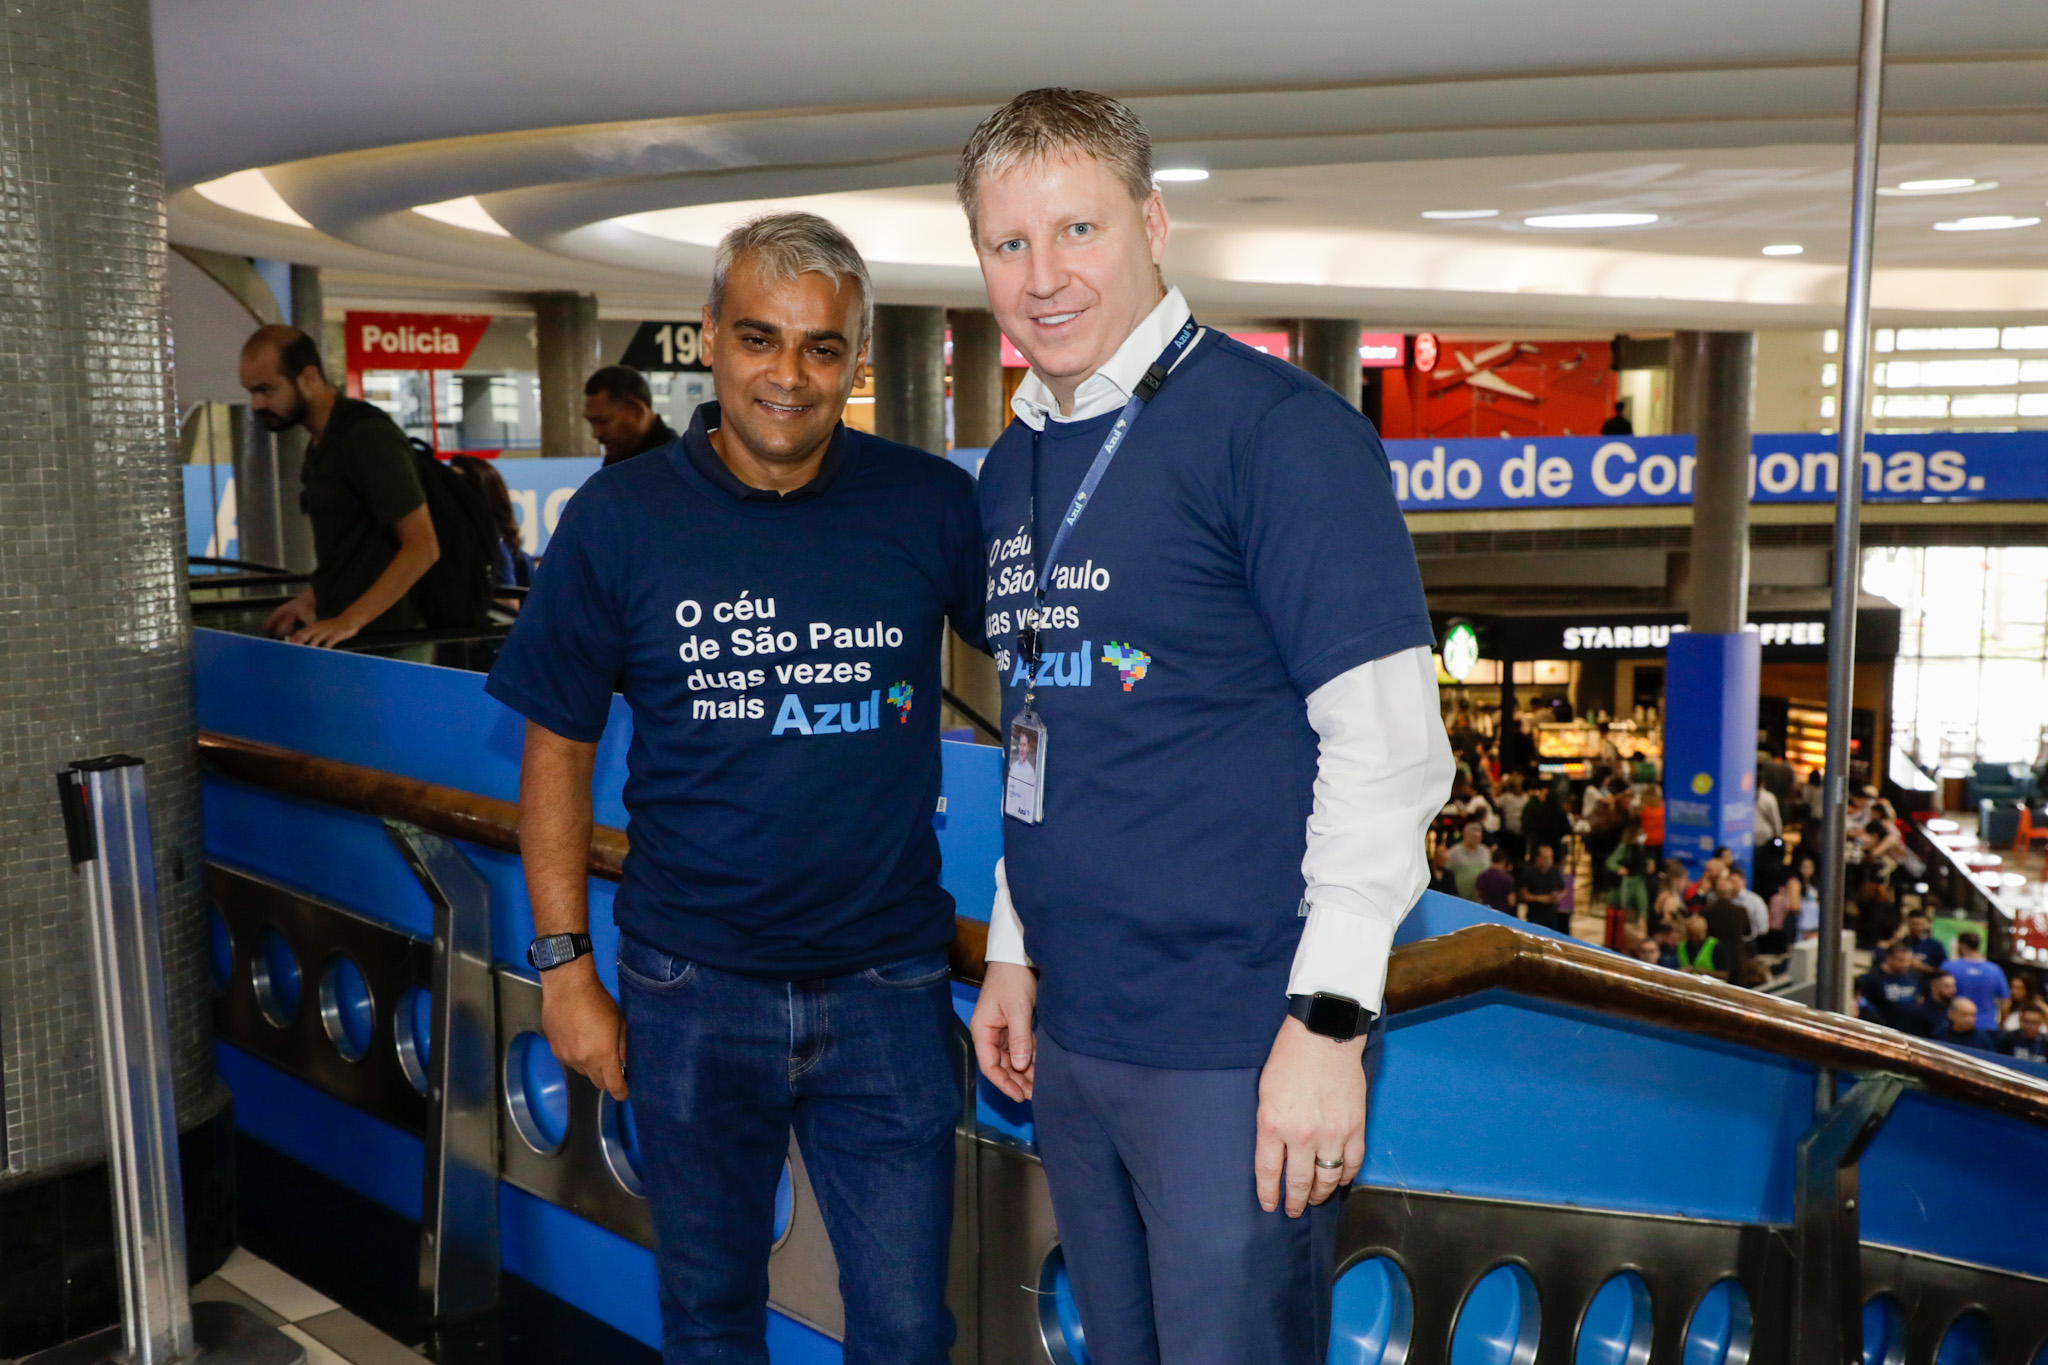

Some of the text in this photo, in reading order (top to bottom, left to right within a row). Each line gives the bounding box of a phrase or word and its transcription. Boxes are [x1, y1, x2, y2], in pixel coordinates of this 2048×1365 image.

[361, 325, 460, 354] Polícia
[655, 325, 702, 365] 19
[1174, 329, 1192, 349] Azul
[1104, 429, 1122, 454] Azul
[1390, 441, 1985, 501] ndo de Coonas.
[1066, 501, 1083, 527] Azul
[989, 525, 1032, 568] O céu
[997, 563, 1035, 597] São
[675, 590, 776, 628] O céu
[986, 605, 1080, 639] uas vezes
[679, 620, 904, 663] de São Paulo
[1562, 622, 1825, 650] STARBU FFEE
[687, 661, 872, 691] duas vezes
[994, 640, 1093, 688] ais Azul
[692, 689, 881, 736] mais Azul
